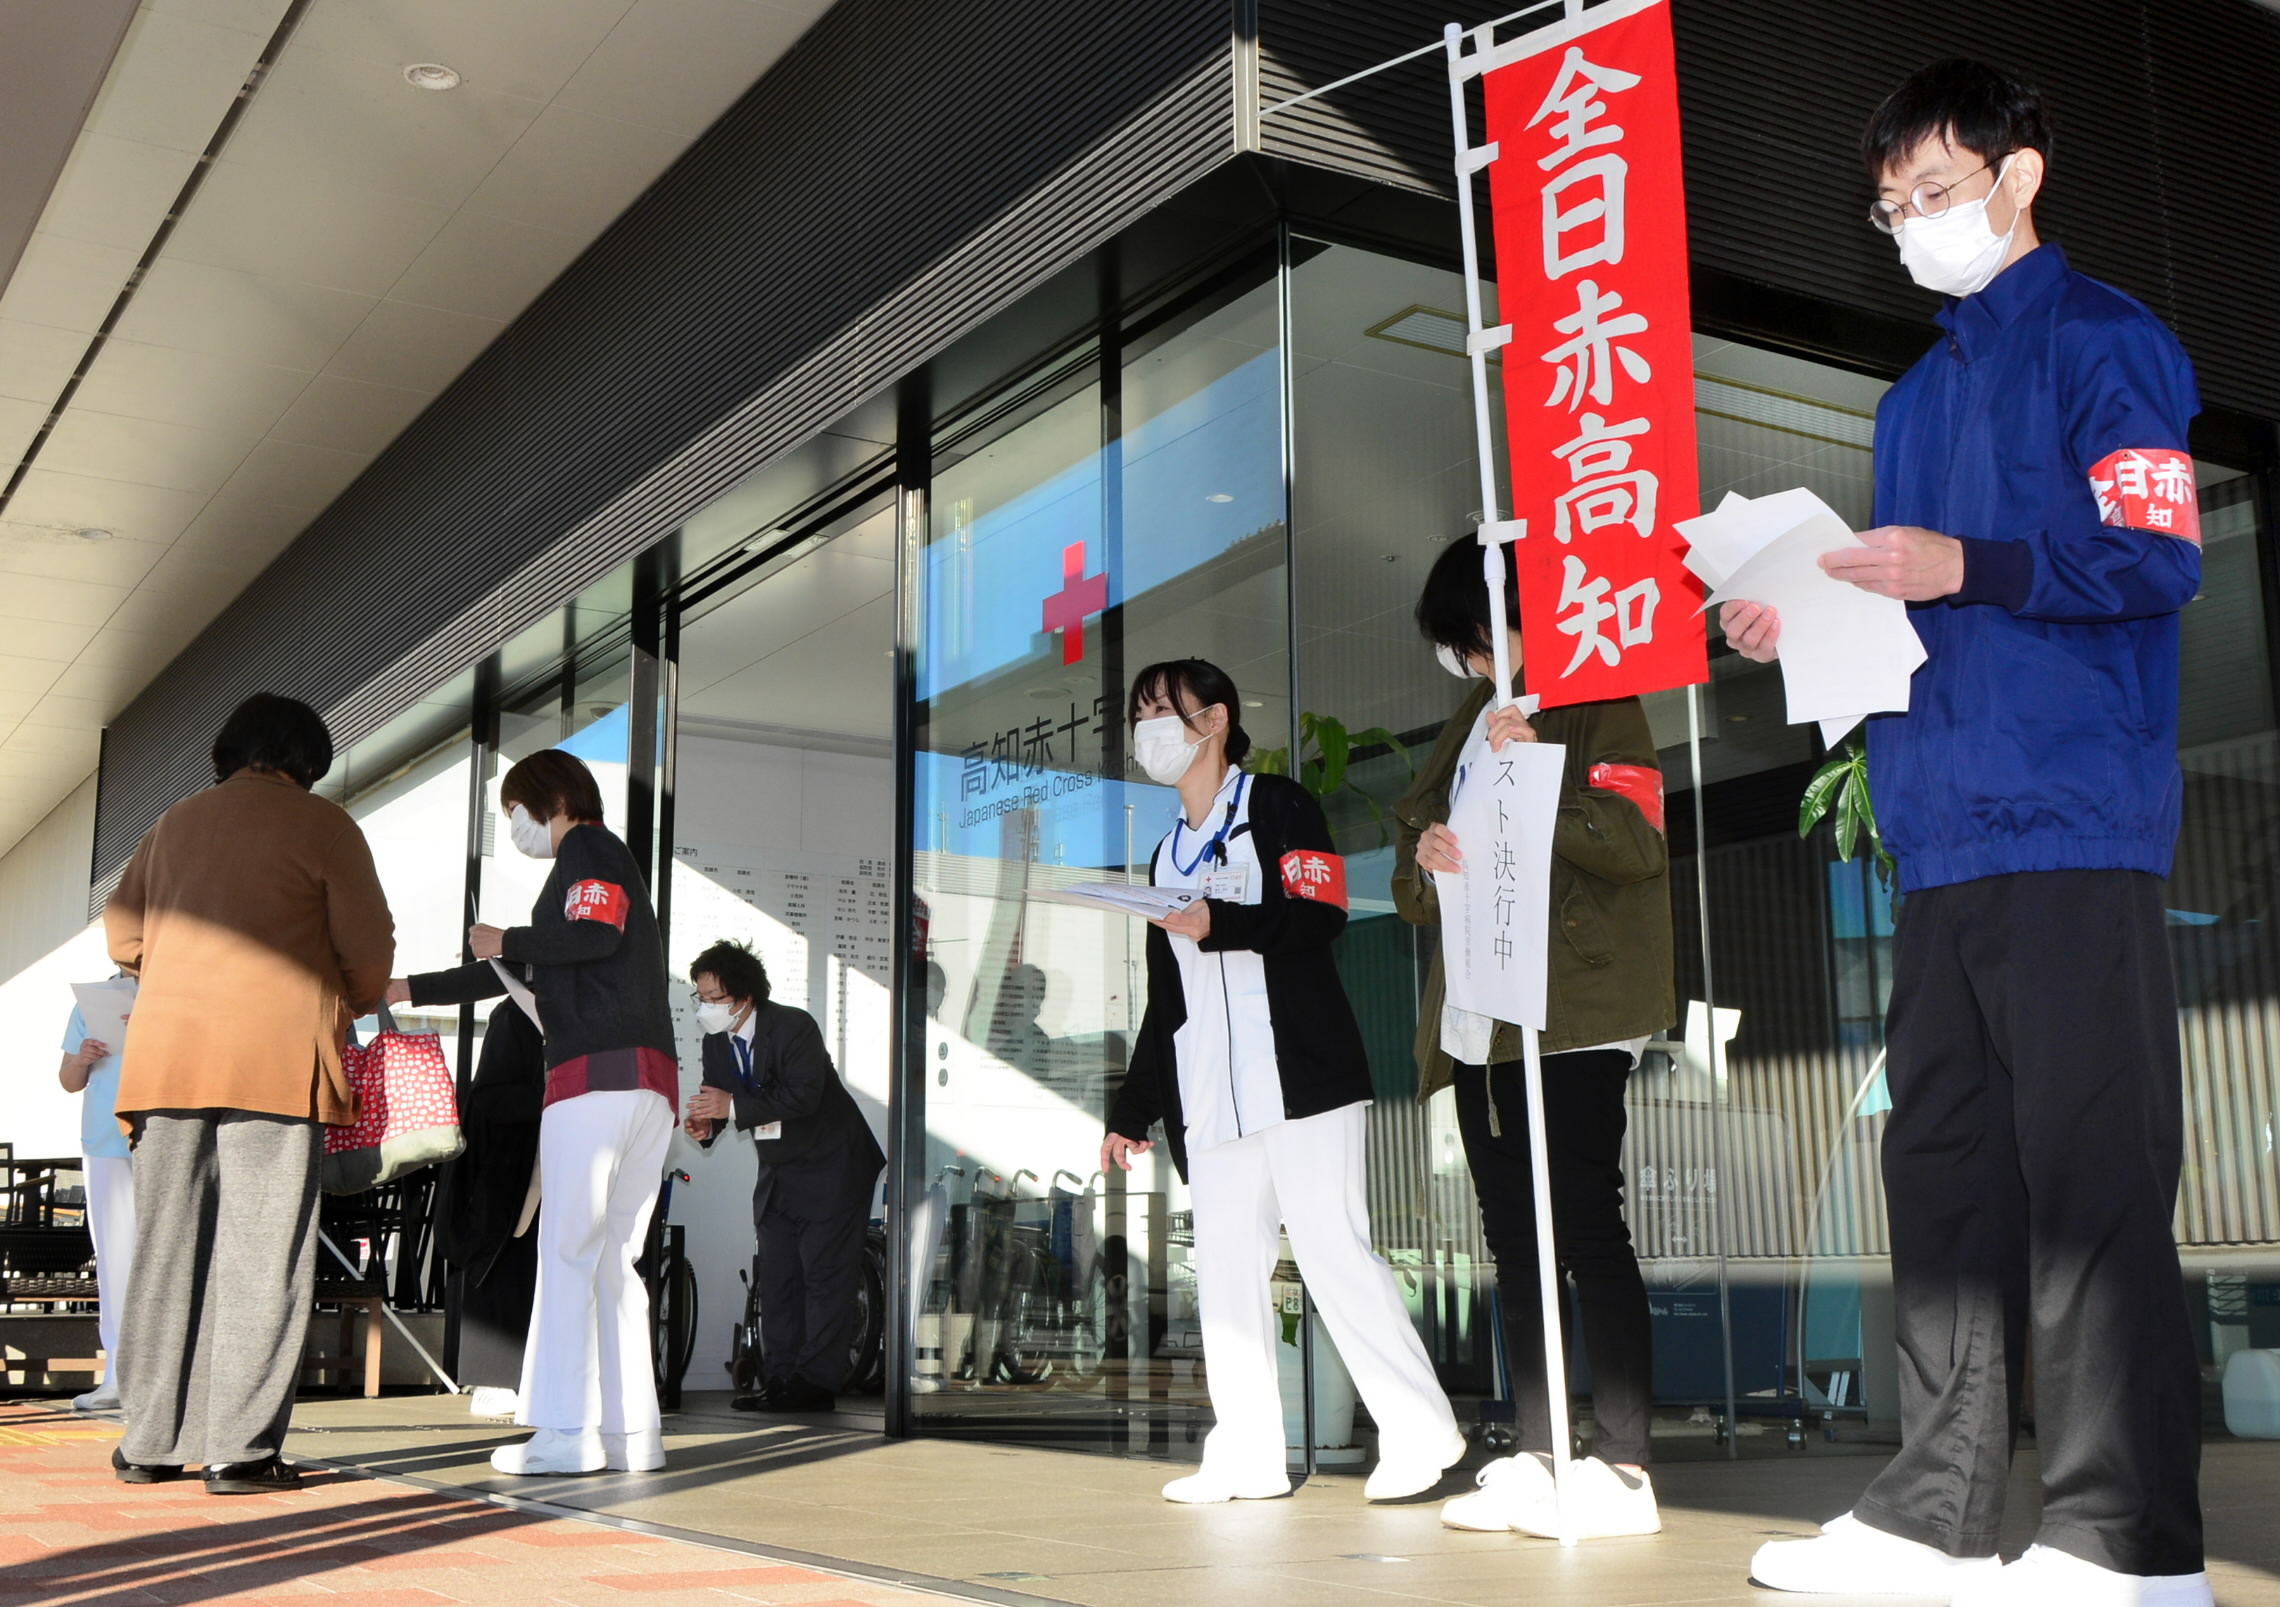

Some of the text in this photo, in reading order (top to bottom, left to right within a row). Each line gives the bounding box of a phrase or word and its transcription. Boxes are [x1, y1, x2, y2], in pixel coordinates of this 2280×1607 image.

[1523, 45, 1660, 679] 全日赤高知
[959, 793, 1019, 829] Japanese
[1023, 780, 1048, 808] Red
[1052, 767, 1093, 797] Cross
[1492, 760, 1516, 971] スト決行中
